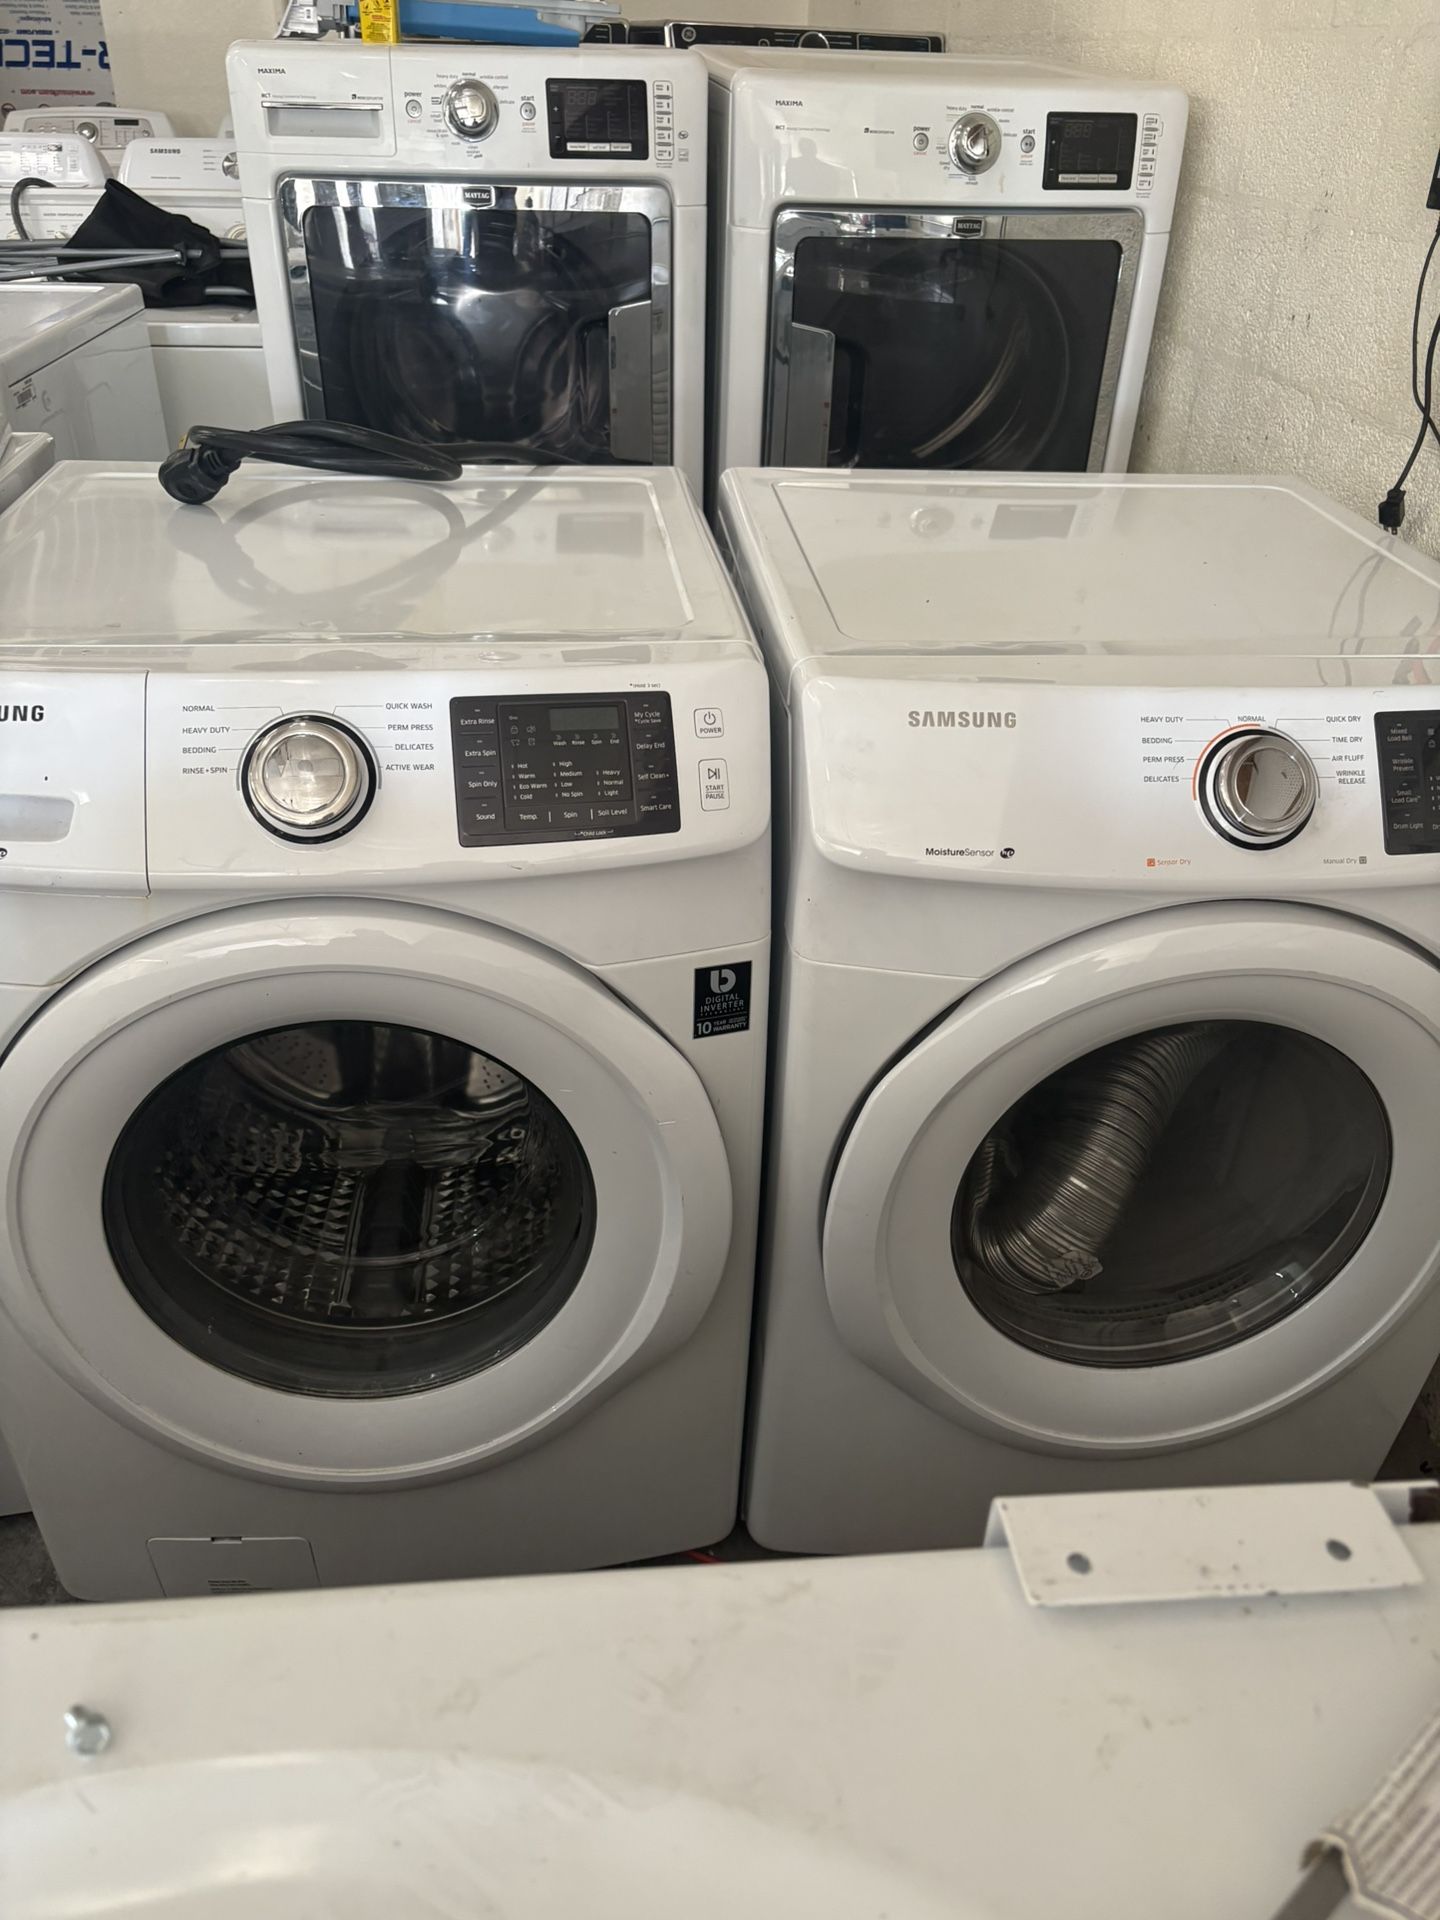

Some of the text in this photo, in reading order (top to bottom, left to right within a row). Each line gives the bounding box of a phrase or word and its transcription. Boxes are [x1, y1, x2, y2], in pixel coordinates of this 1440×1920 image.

[0, 38, 110, 69] R-TEC
[464, 191, 490, 199] MAYTAG
[385, 702, 409, 710] QUICK
[460, 718, 477, 726] Extra
[908, 710, 1017, 728] SAMSUNG
[1326, 715, 1347, 723] QUICK
[182, 746, 217, 754] BEDDING
[394, 743, 434, 751] DELICATES
[482, 749, 497, 757] Spin
[1143, 775, 1180, 783] DELICATES
[483, 780, 498, 788] Only
[611, 808, 627, 816] Level
[640, 804, 657, 812] Smart
[476, 813, 496, 821] Sound
[563, 811, 578, 819] Spin
[925, 847, 995, 857] MoistureSensor
[1179, 858, 1192, 866] Dry
[1345, 857, 1358, 865] Dry
[705, 993, 740, 1005] DIGITAL
[700, 1000, 745, 1013] INVERTER
[697, 1021, 712, 1035] 10
[713, 1021, 747, 1032] WARRANTY
